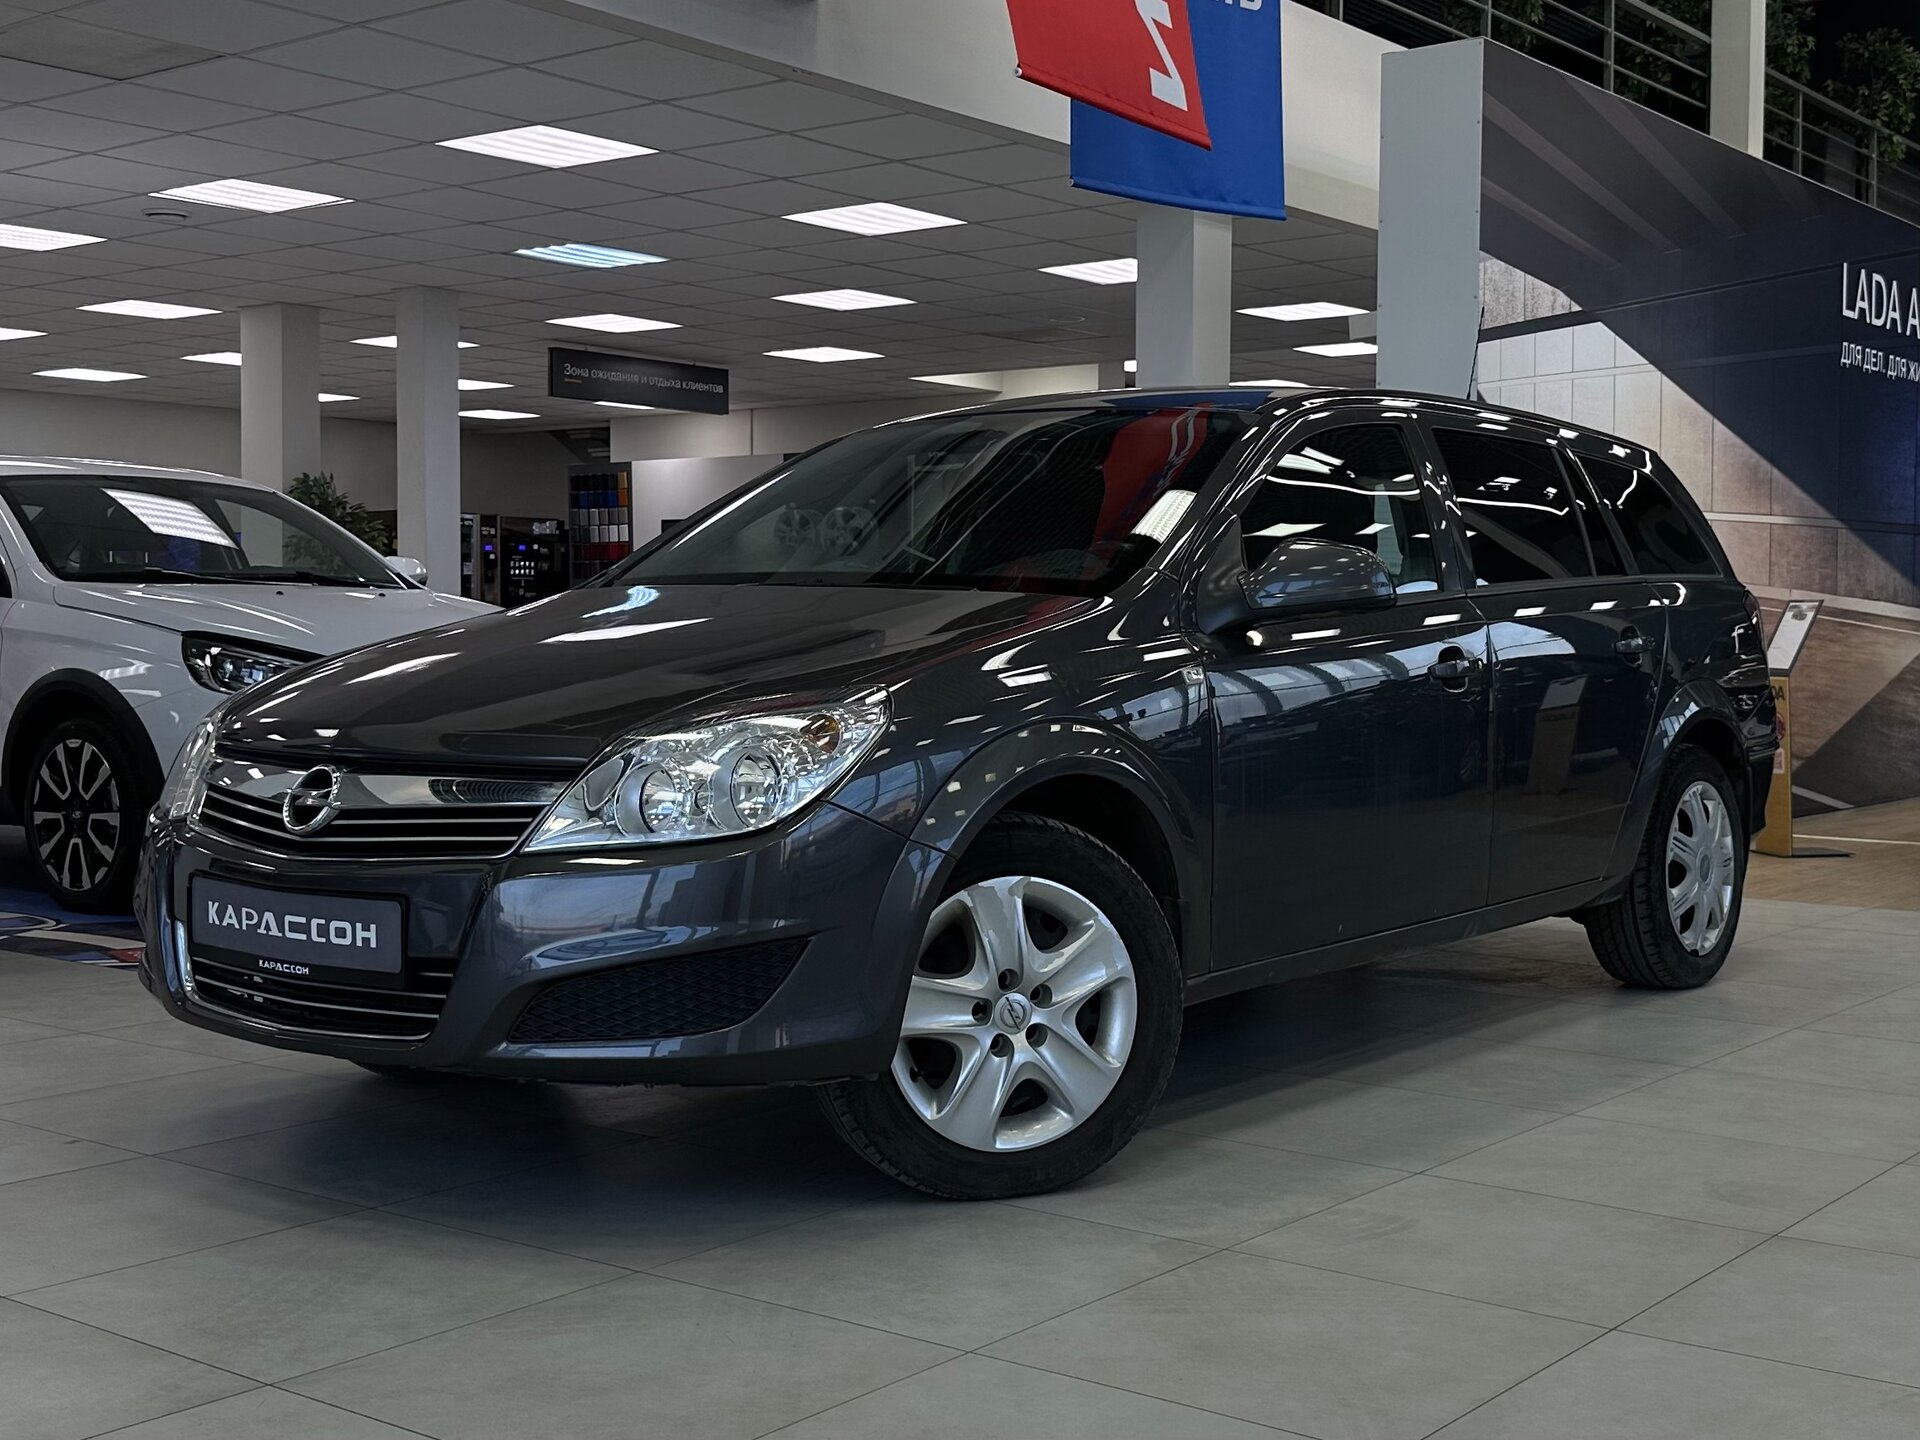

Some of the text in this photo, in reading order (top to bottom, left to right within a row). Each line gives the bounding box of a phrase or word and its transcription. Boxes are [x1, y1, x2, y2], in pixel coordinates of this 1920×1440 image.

[1842, 262, 1902, 334] LADA
[563, 363, 724, 393] Зона ожидания и отдыха клиентов
[1840, 341, 1862, 368] ДЛЯ
[1863, 348, 1886, 374] ДЕЛ.
[1887, 355, 1907, 380] ДЛЯ
[208, 900, 377, 948] КАРАССОН
[258, 959, 310, 975] КАРАССОН
